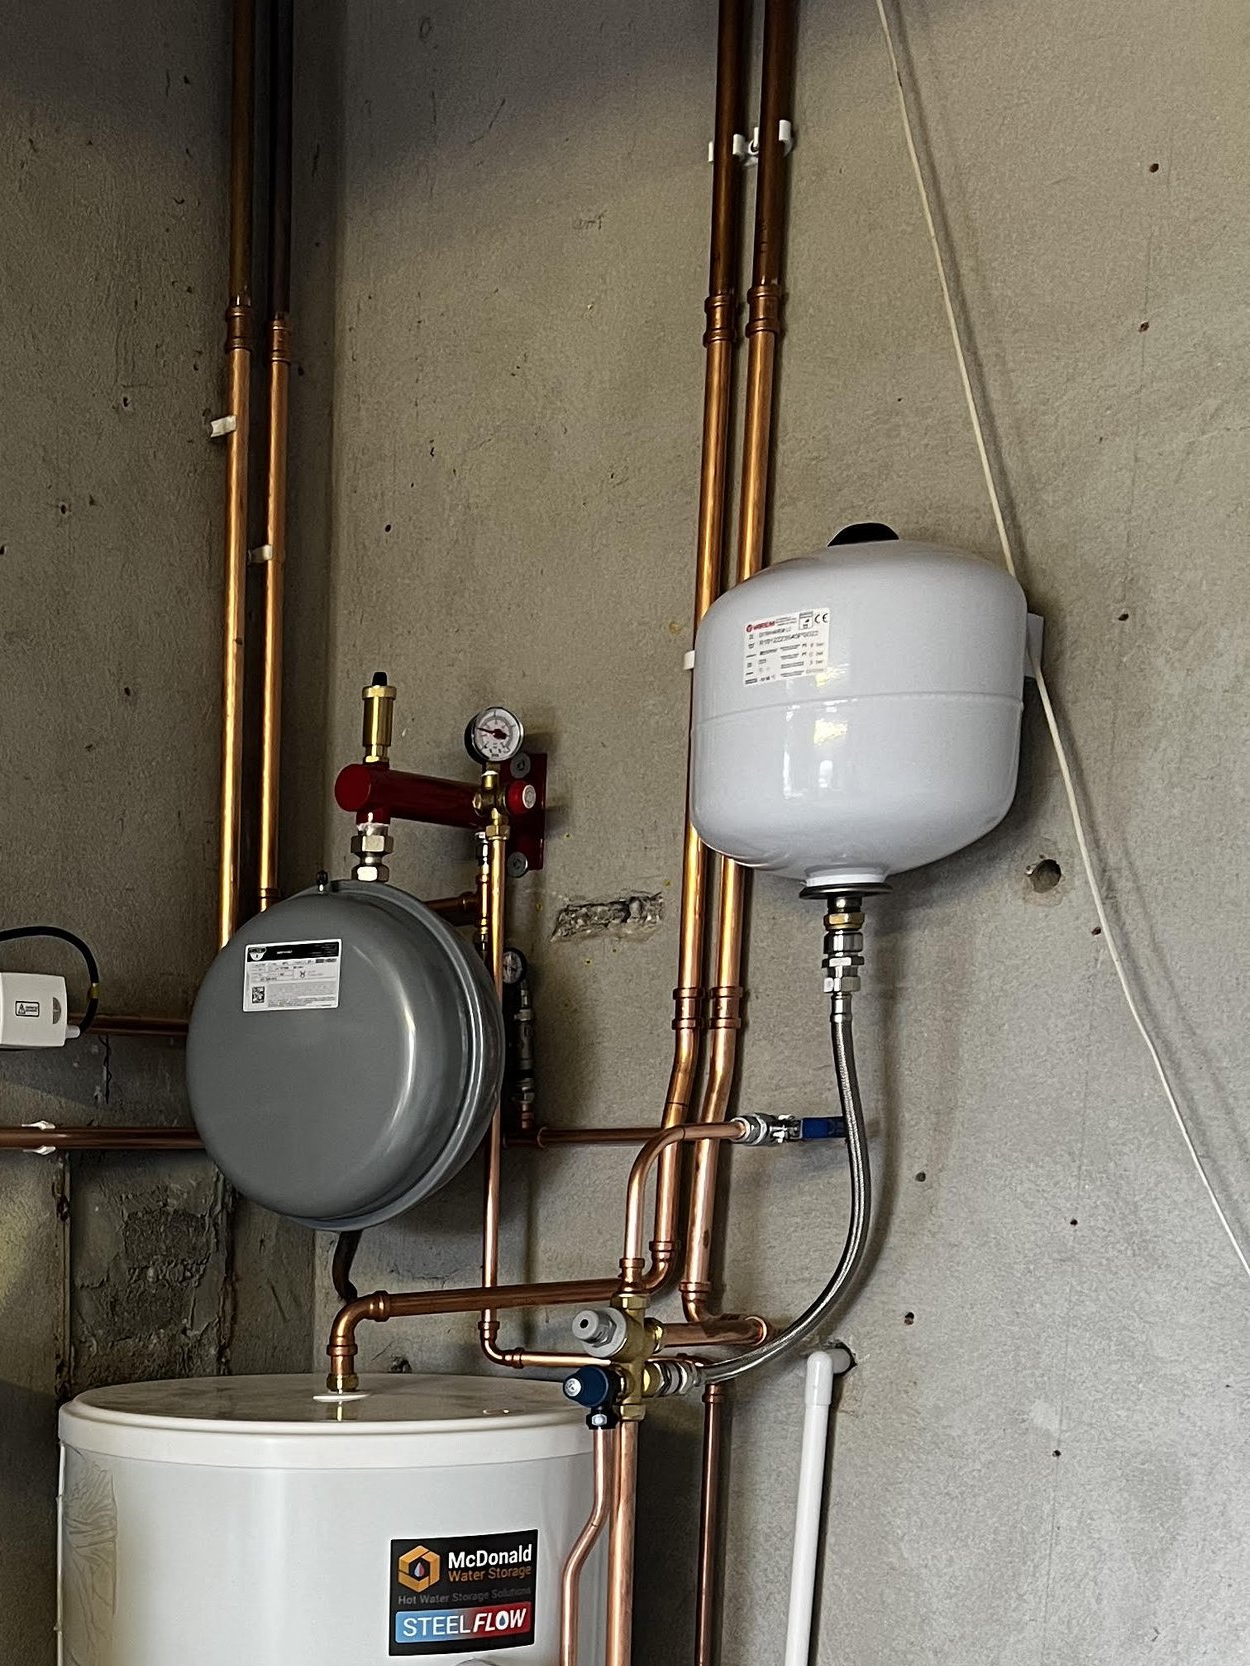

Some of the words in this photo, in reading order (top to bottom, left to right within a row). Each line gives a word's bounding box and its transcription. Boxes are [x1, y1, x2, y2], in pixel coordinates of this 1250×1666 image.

[448, 1543, 532, 1569] McDonald
[448, 1570, 485, 1582] Water
[488, 1565, 532, 1580] Storage
[398, 1595, 417, 1605] Hot
[419, 1594, 449, 1604] Water
[452, 1590, 489, 1603] Storage
[491, 1586, 532, 1599] Solutions
